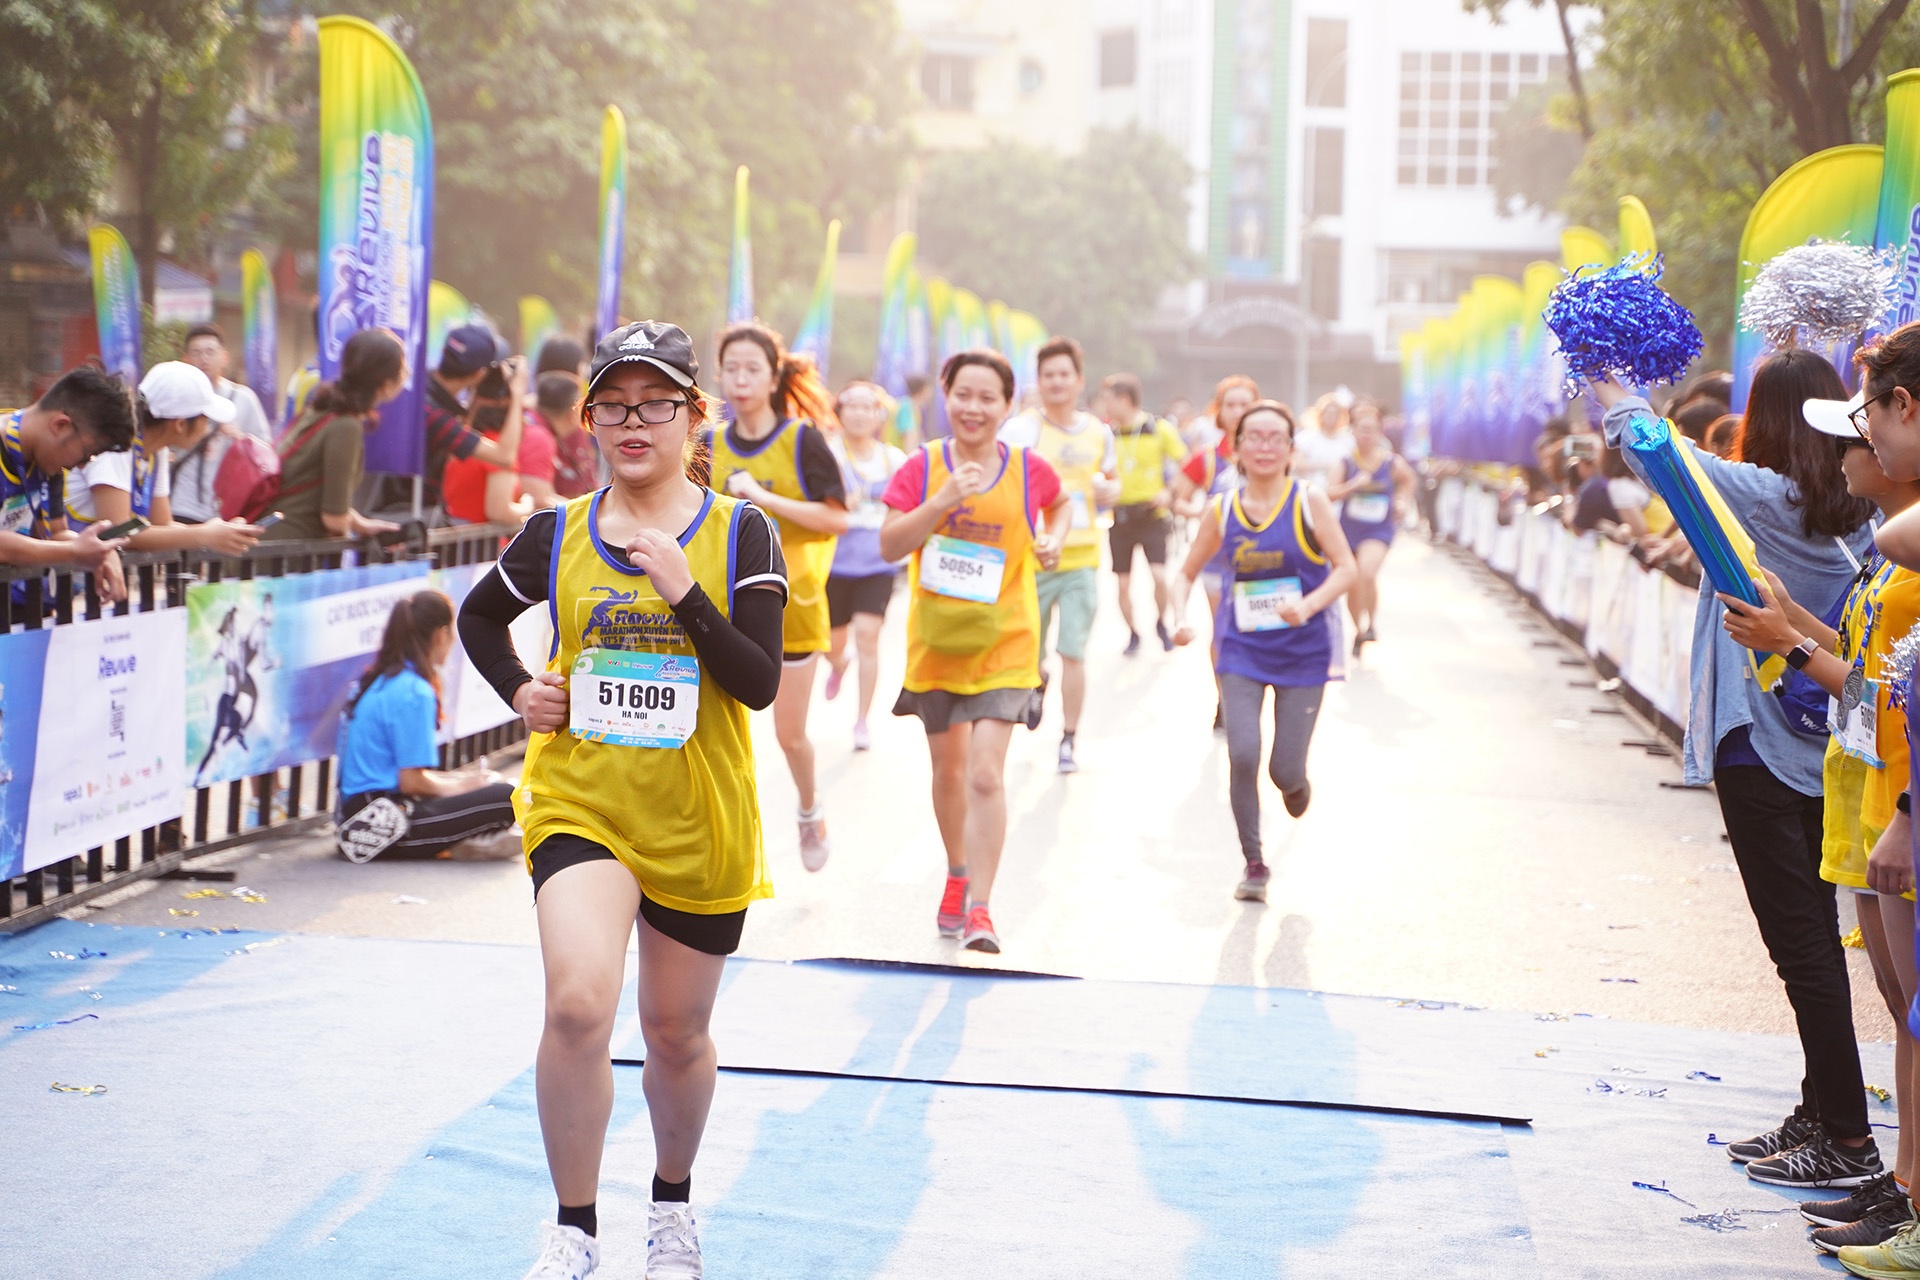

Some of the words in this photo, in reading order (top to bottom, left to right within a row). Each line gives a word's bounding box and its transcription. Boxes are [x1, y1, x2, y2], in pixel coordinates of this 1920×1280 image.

[355, 134, 381, 300] Revive
[618, 343, 655, 352] adidas
[938, 556, 984, 577] 50854
[600, 625, 643, 636] MARATHON
[644, 624, 669, 635] XUYÊN
[601, 635, 618, 645] LET'S
[619, 635, 637, 645] MOVE
[639, 635, 667, 645] VIETNAM
[669, 664, 697, 674] Revive
[598, 680, 676, 711] 51609
[621, 710, 632, 719] HA
[634, 711, 648, 720] NOI
